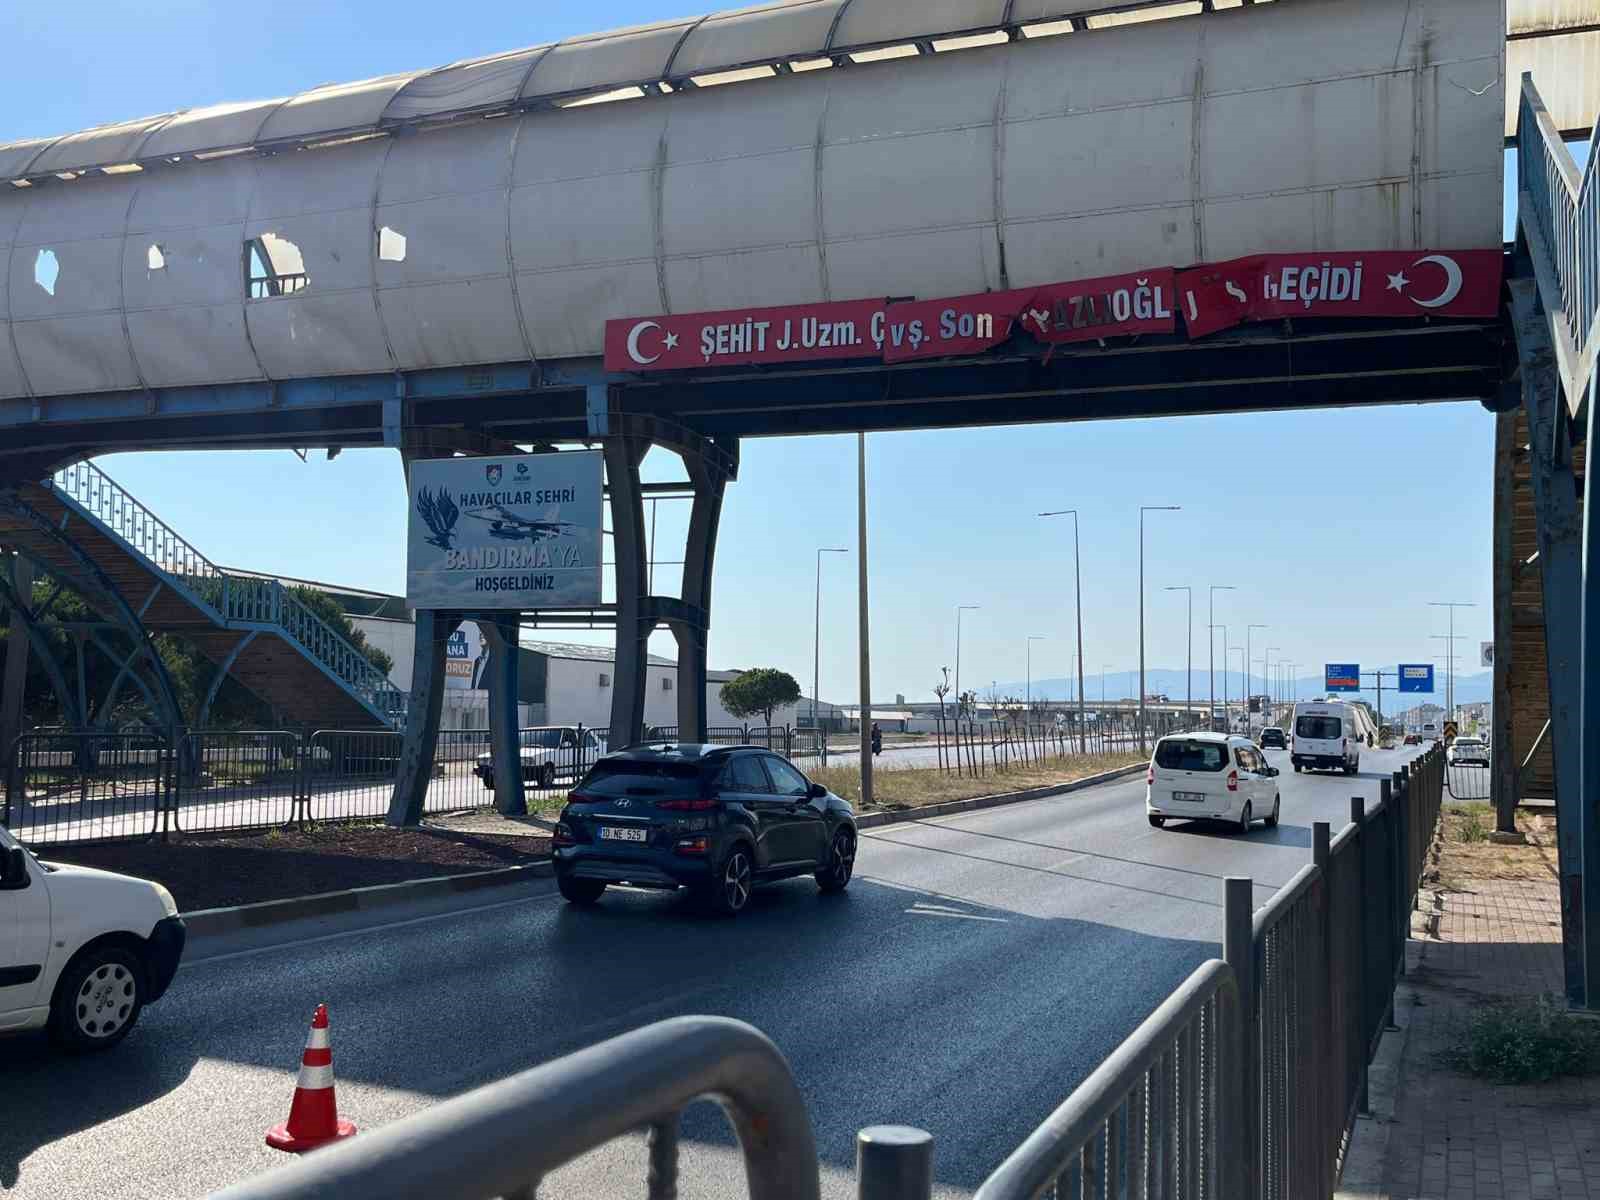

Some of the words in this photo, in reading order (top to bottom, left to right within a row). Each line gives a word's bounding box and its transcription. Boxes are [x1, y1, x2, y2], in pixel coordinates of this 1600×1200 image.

[700, 317, 770, 363] ŞEHİT
[940, 308, 993, 339] Son
[459, 490, 531, 508] HAVACILAR
[536, 486, 576, 507] ŞEHRİ
[475, 575, 555, 593] HOŞGELDİNİZ
